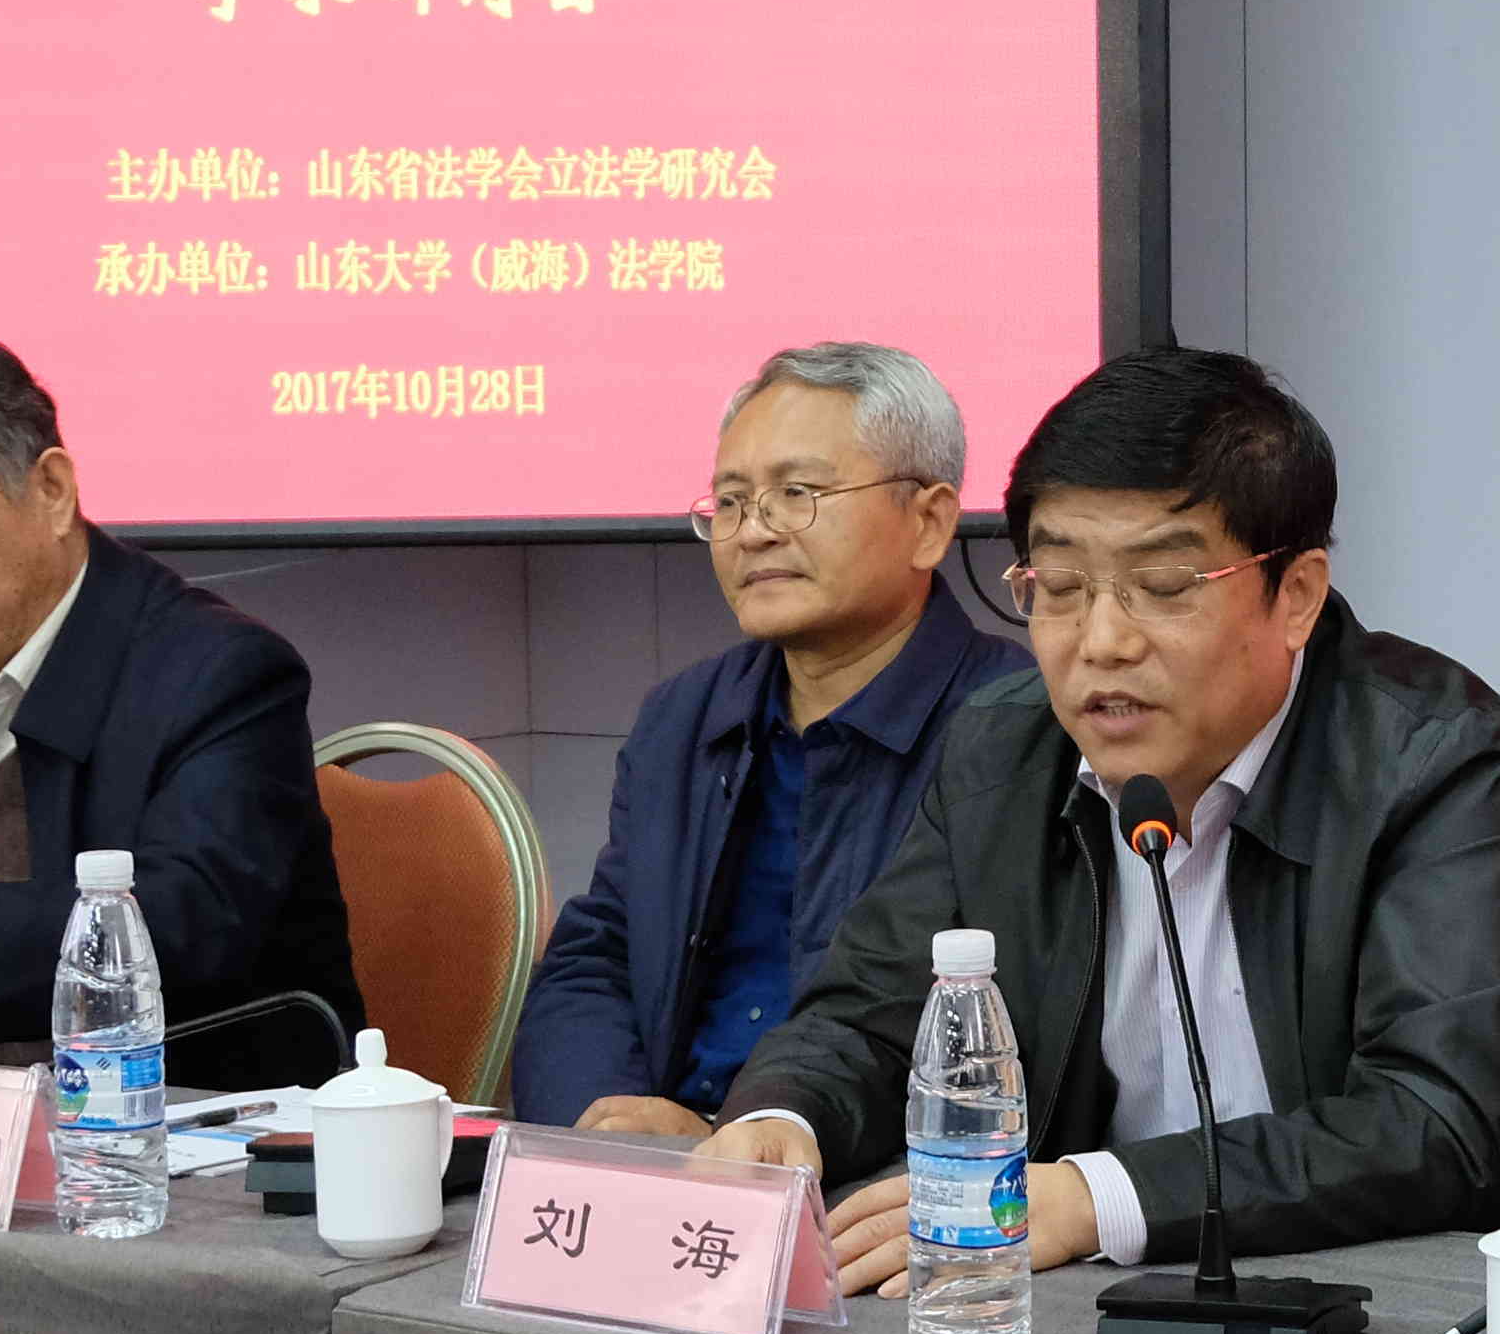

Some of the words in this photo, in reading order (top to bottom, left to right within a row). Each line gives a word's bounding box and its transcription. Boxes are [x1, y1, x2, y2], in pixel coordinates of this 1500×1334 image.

[108, 146, 776, 202] 主办单位：山东省法学会立法学研究会
[272, 365, 544, 417] 2017年10月28日
